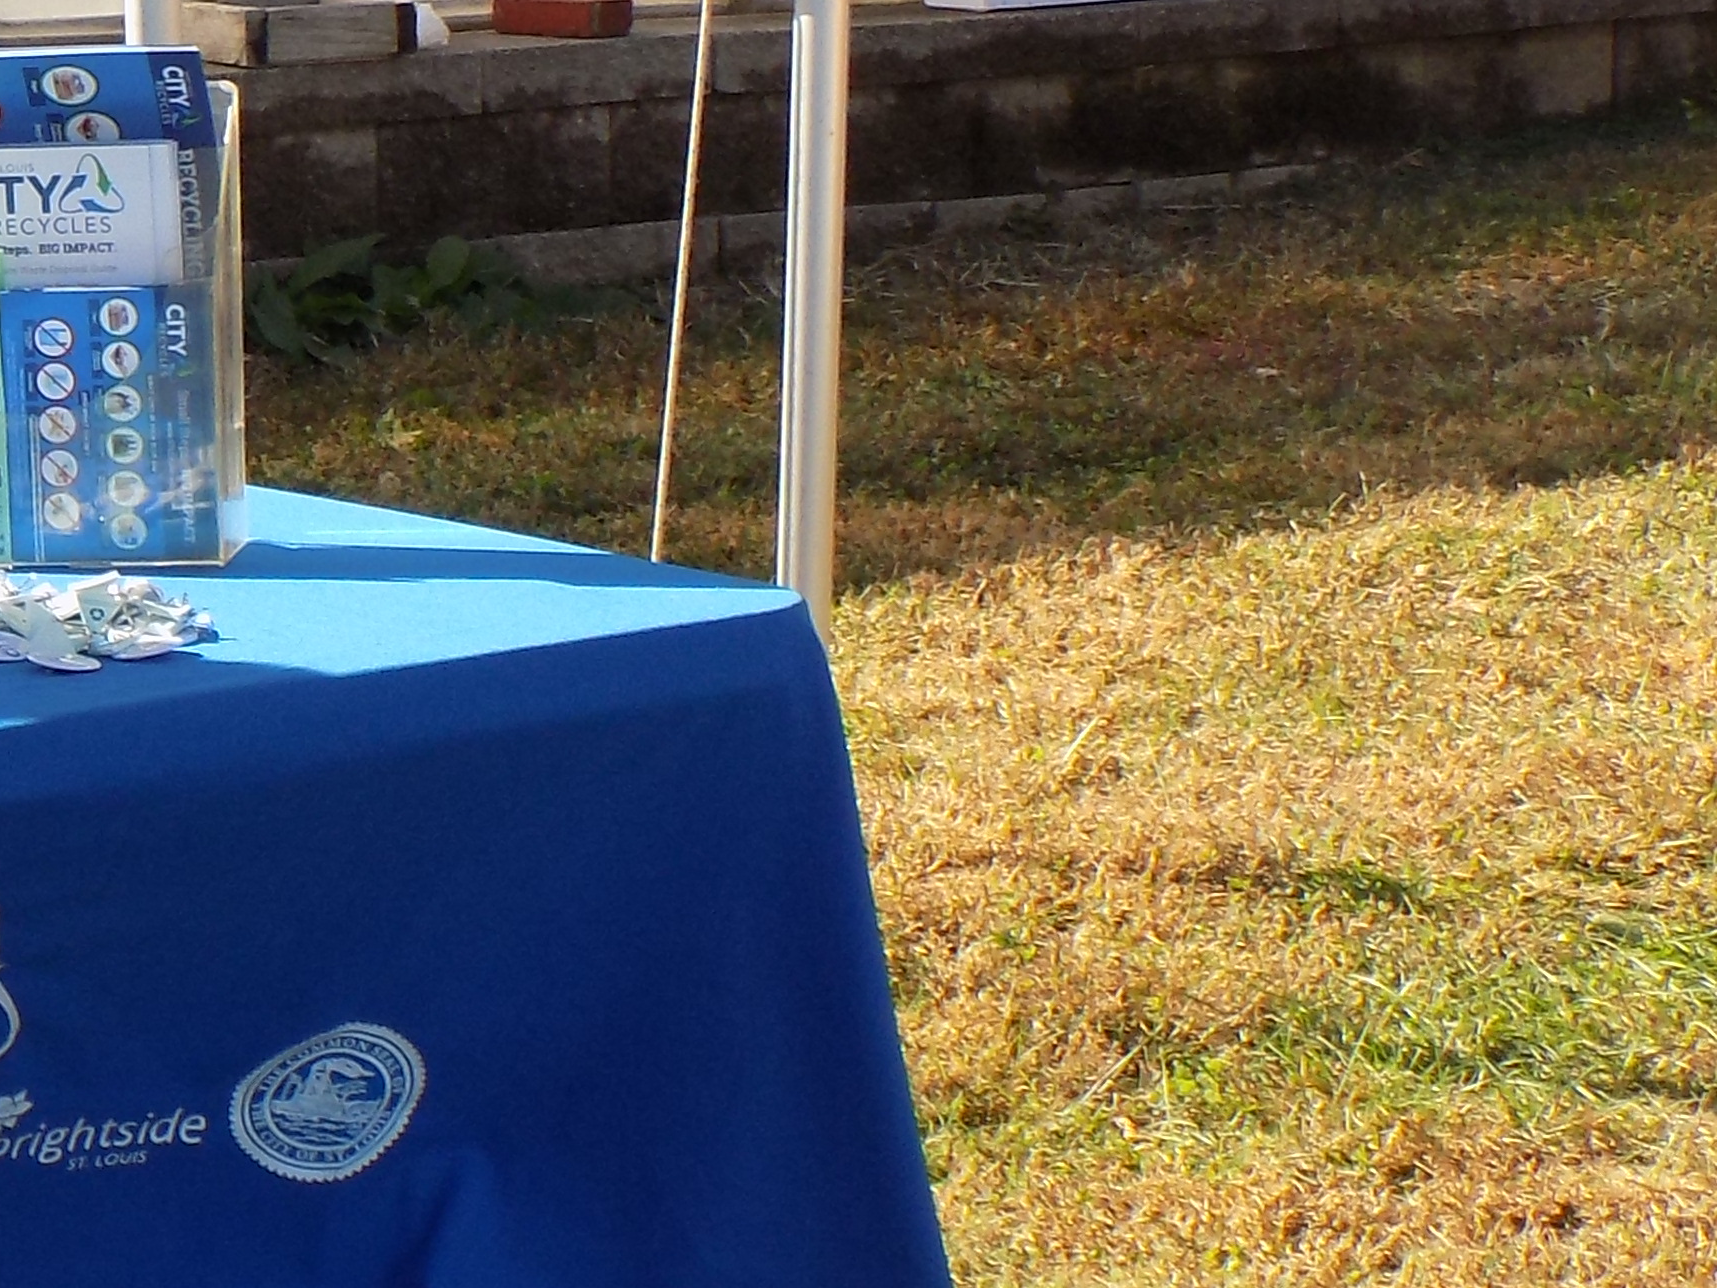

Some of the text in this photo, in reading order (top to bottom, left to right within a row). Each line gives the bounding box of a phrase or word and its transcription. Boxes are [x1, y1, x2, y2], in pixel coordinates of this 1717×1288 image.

[161, 65, 191, 109] CITY
[38, 242, 61, 255] BIG
[166, 303, 188, 358] CITY
[95, 1150, 148, 1168] LOUIS
